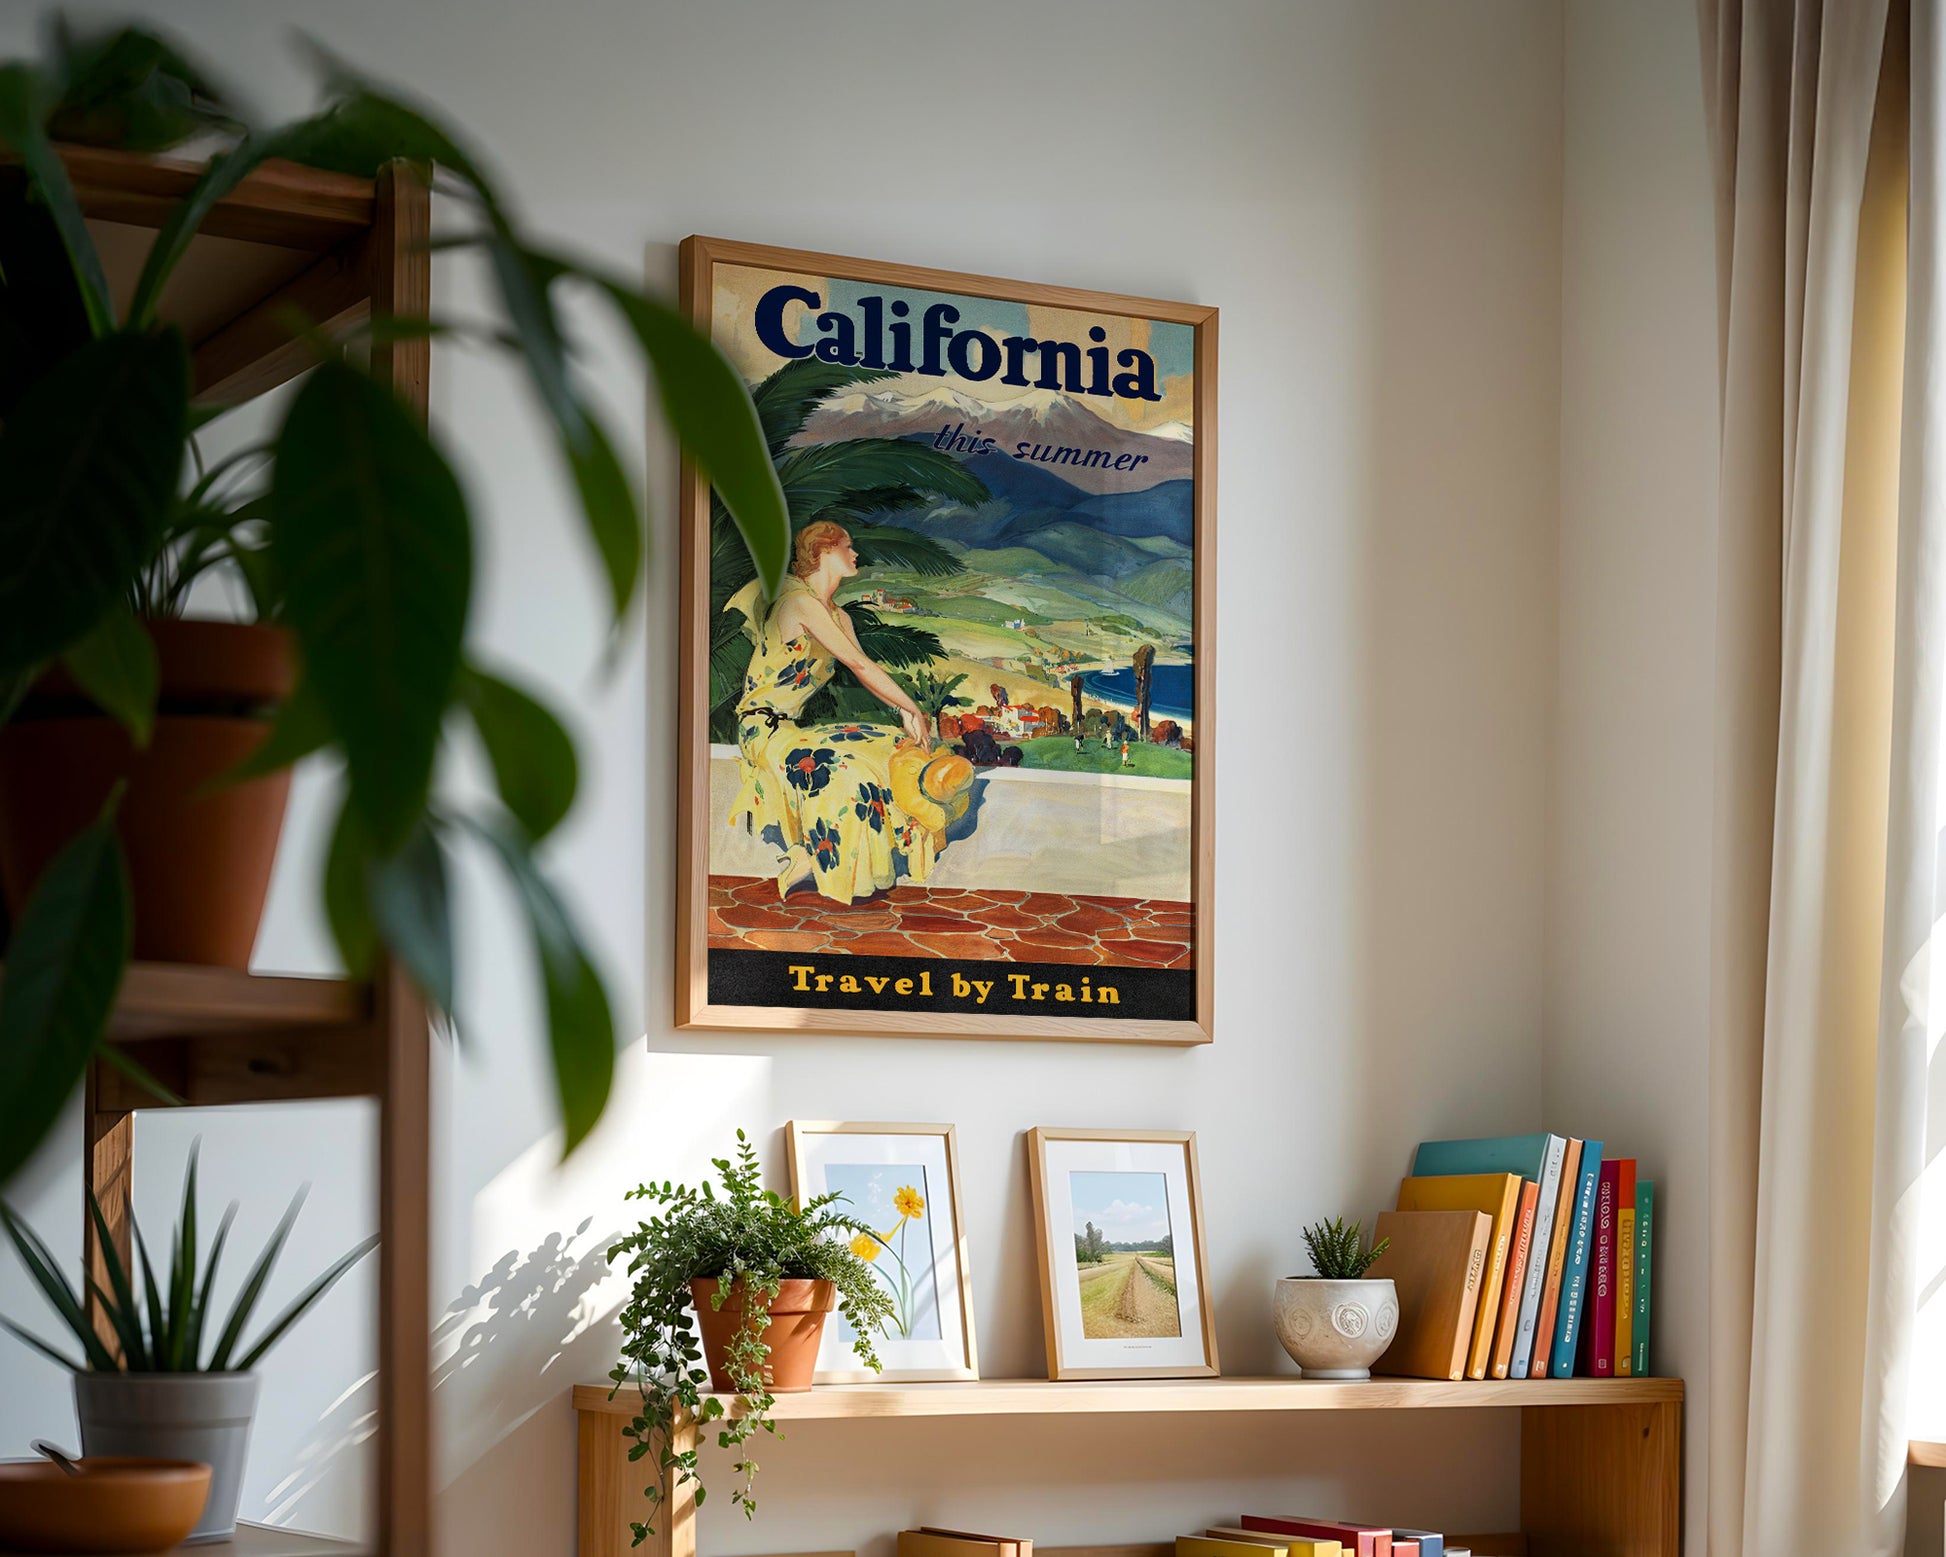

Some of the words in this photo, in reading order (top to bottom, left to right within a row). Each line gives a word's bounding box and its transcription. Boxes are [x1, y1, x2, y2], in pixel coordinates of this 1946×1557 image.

[754, 285, 1162, 402] California
[933, 423, 997, 456] this
[1012, 439, 1149, 473] summer
[788, 965, 933, 996] Travel
[951, 973, 995, 1004] by
[1007, 974, 1121, 1004] Train
